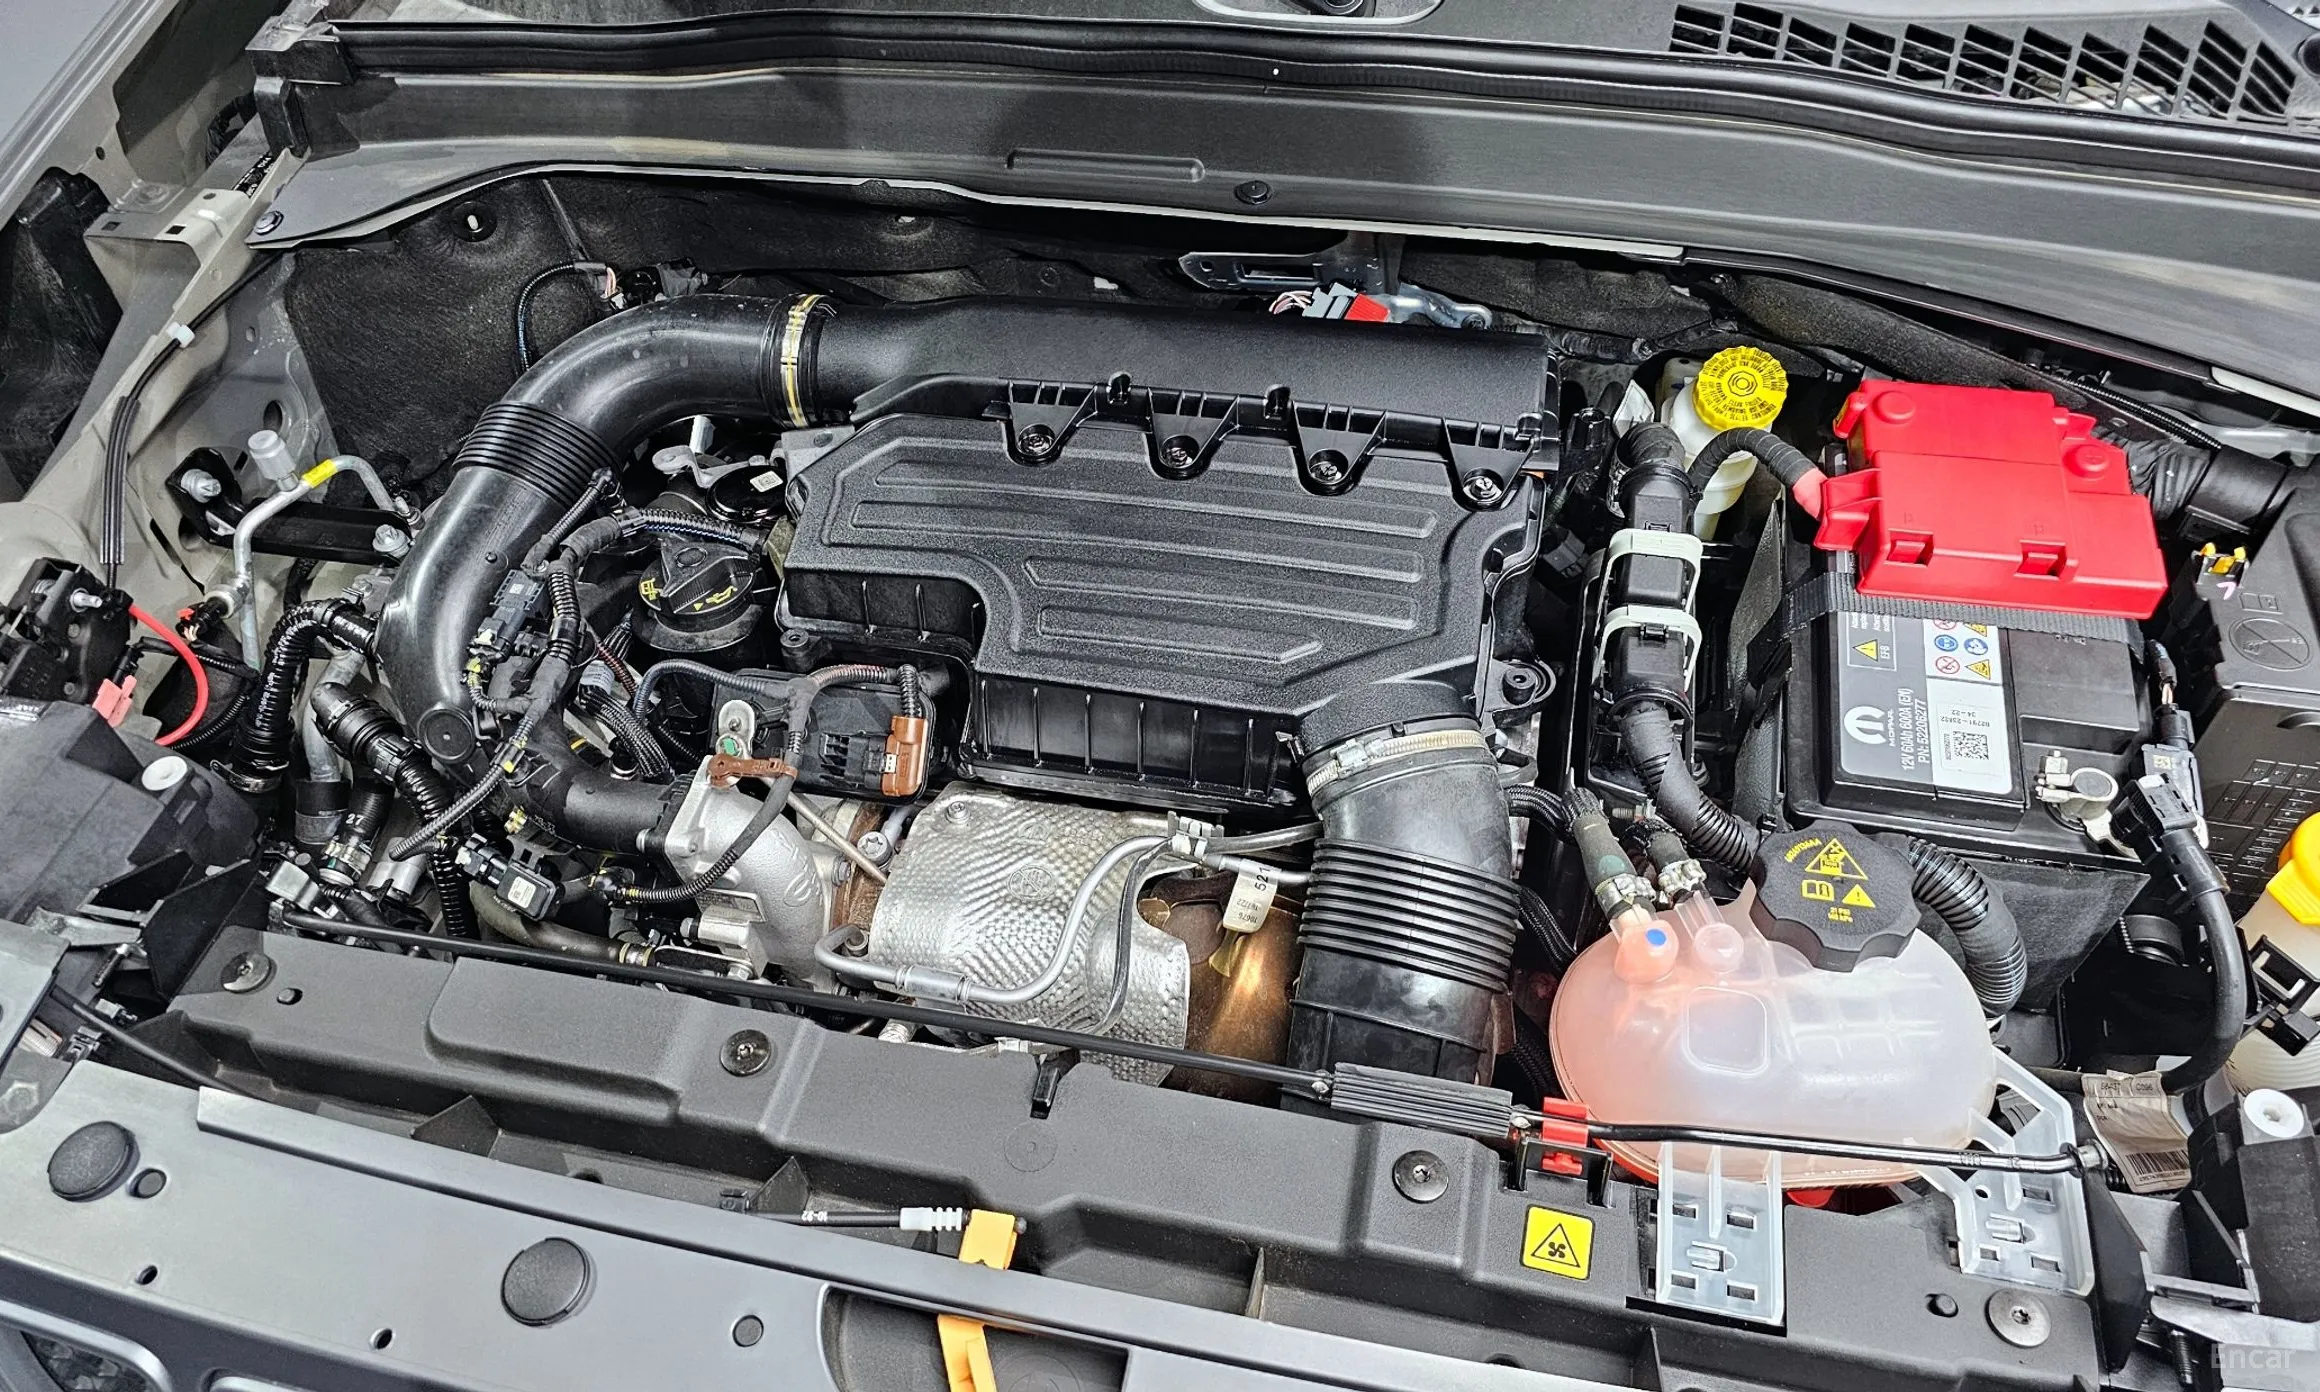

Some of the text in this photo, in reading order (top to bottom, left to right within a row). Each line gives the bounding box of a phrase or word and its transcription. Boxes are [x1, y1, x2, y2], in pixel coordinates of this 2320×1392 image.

[1887, 709, 1896, 747] MOPAR
[1897, 688, 1916, 770] 12V 60Ah 600A (EN)
[1914, 698, 1931, 765] PN: 52206277
[345, 813, 365, 826] 27
[1255, 867, 1271, 892] 521
